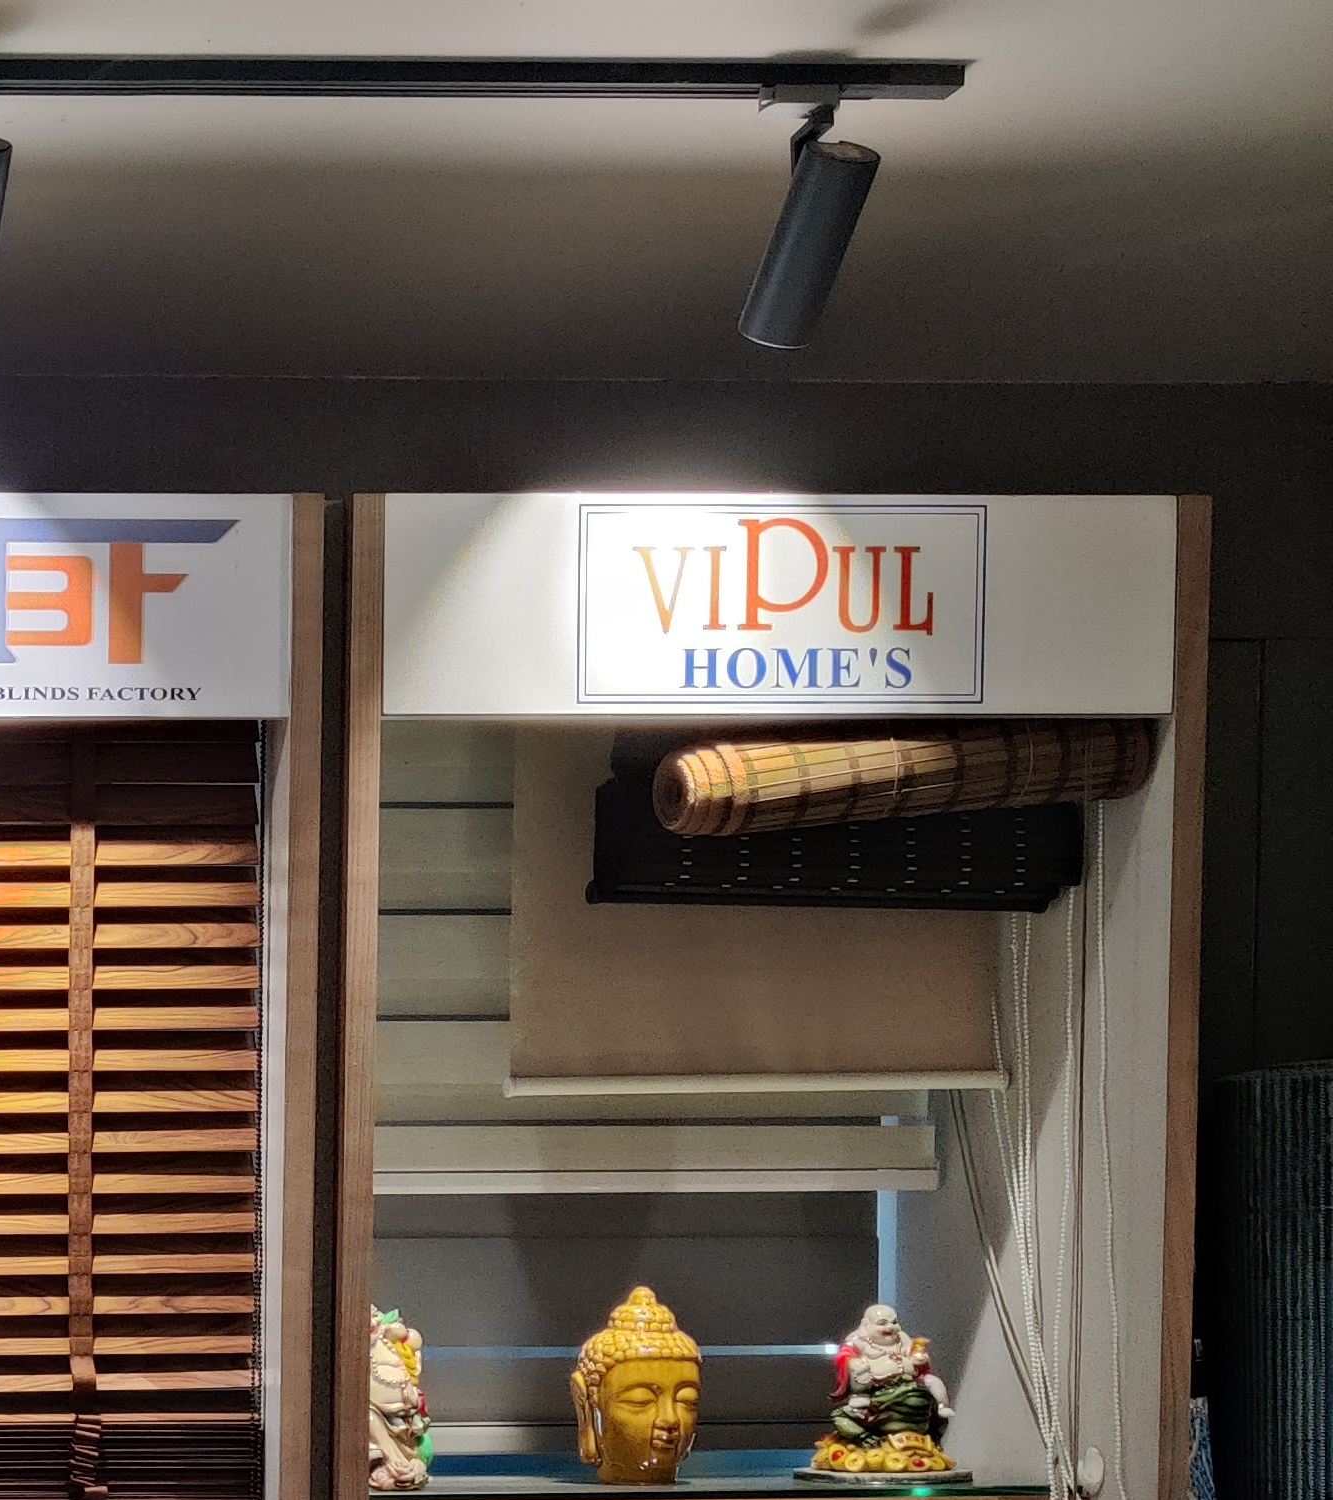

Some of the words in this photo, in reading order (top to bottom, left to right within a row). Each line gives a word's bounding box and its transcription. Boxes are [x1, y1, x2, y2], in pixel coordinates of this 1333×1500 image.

[633, 517, 934, 636] VIPUL
[680, 647, 912, 690] HOME'S
[86, 686, 203, 701] FACTORY
